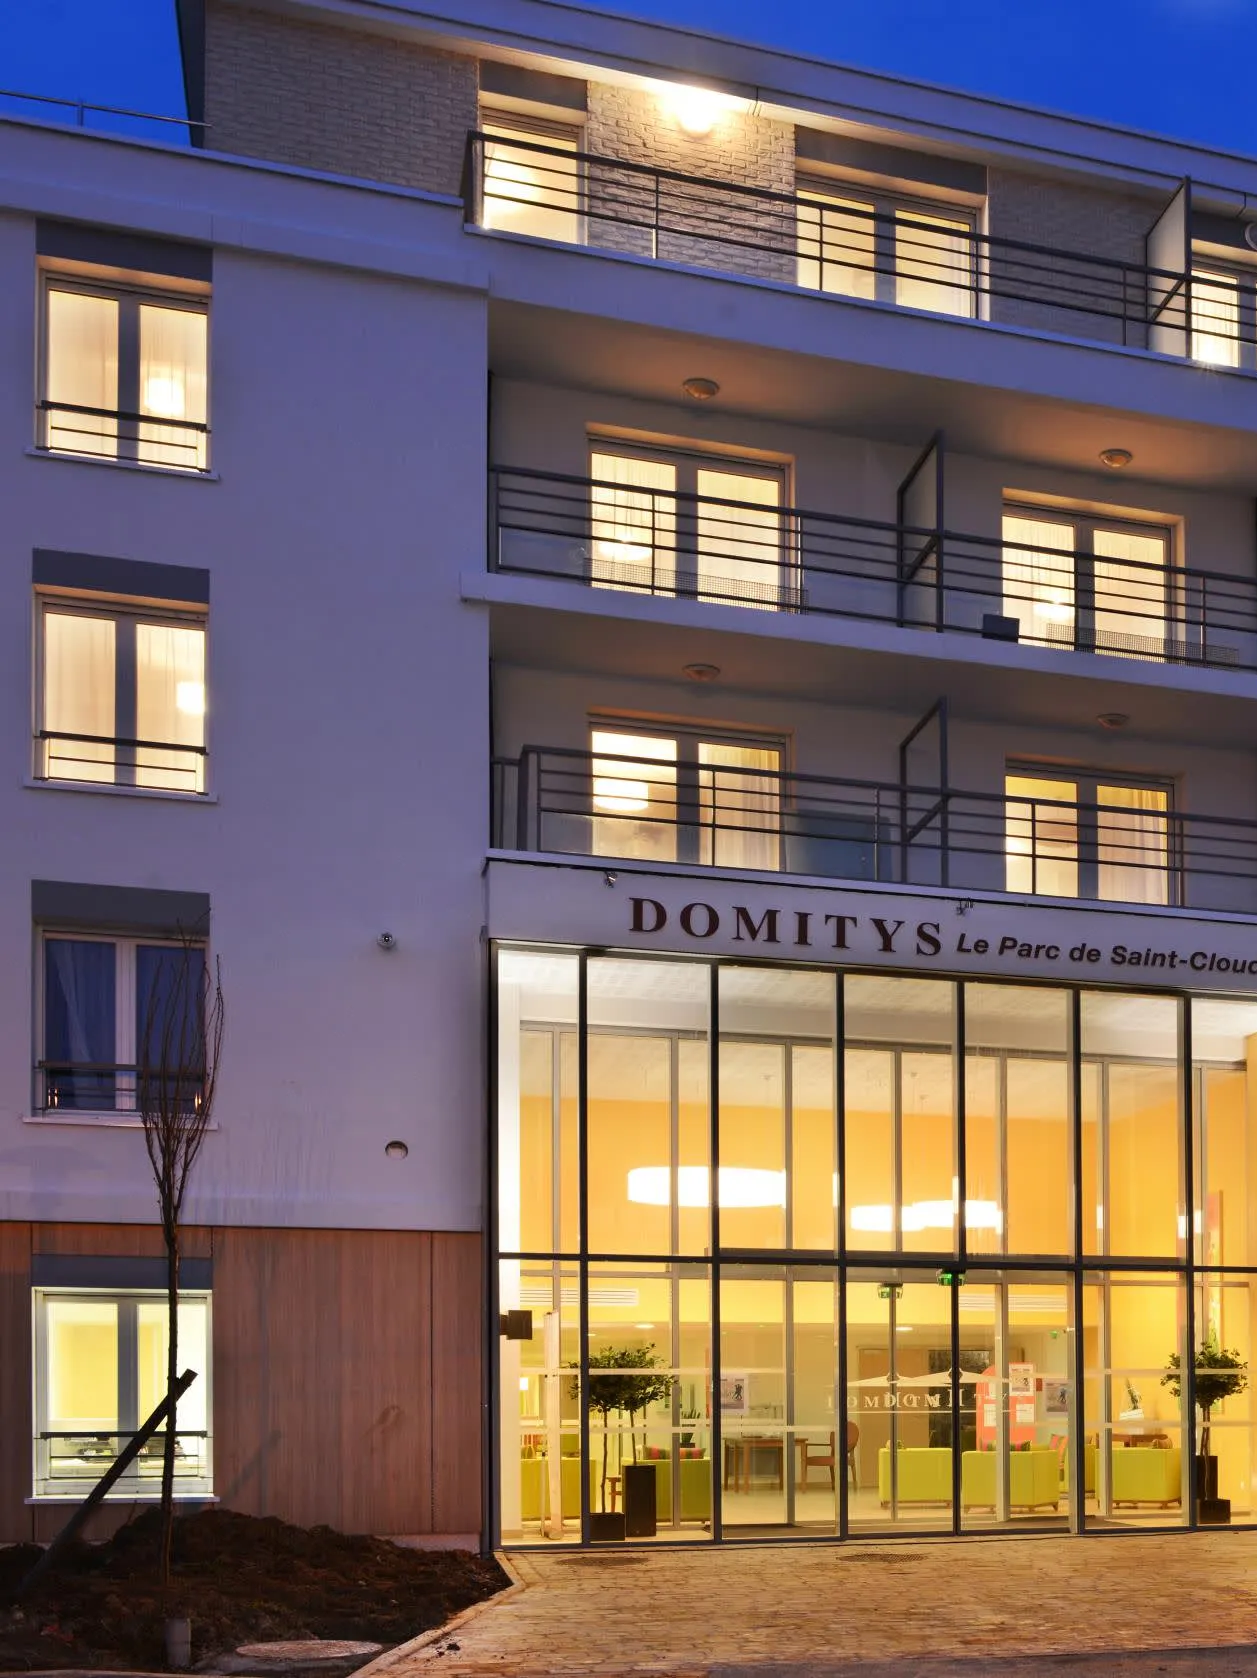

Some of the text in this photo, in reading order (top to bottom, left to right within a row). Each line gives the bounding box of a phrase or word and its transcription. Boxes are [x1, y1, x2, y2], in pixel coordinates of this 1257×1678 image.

[628, 897, 942, 956] DOMITYS
[956, 933, 989, 954] Le
[998, 936, 1060, 959] Parc
[1069, 943, 1101, 963] de
